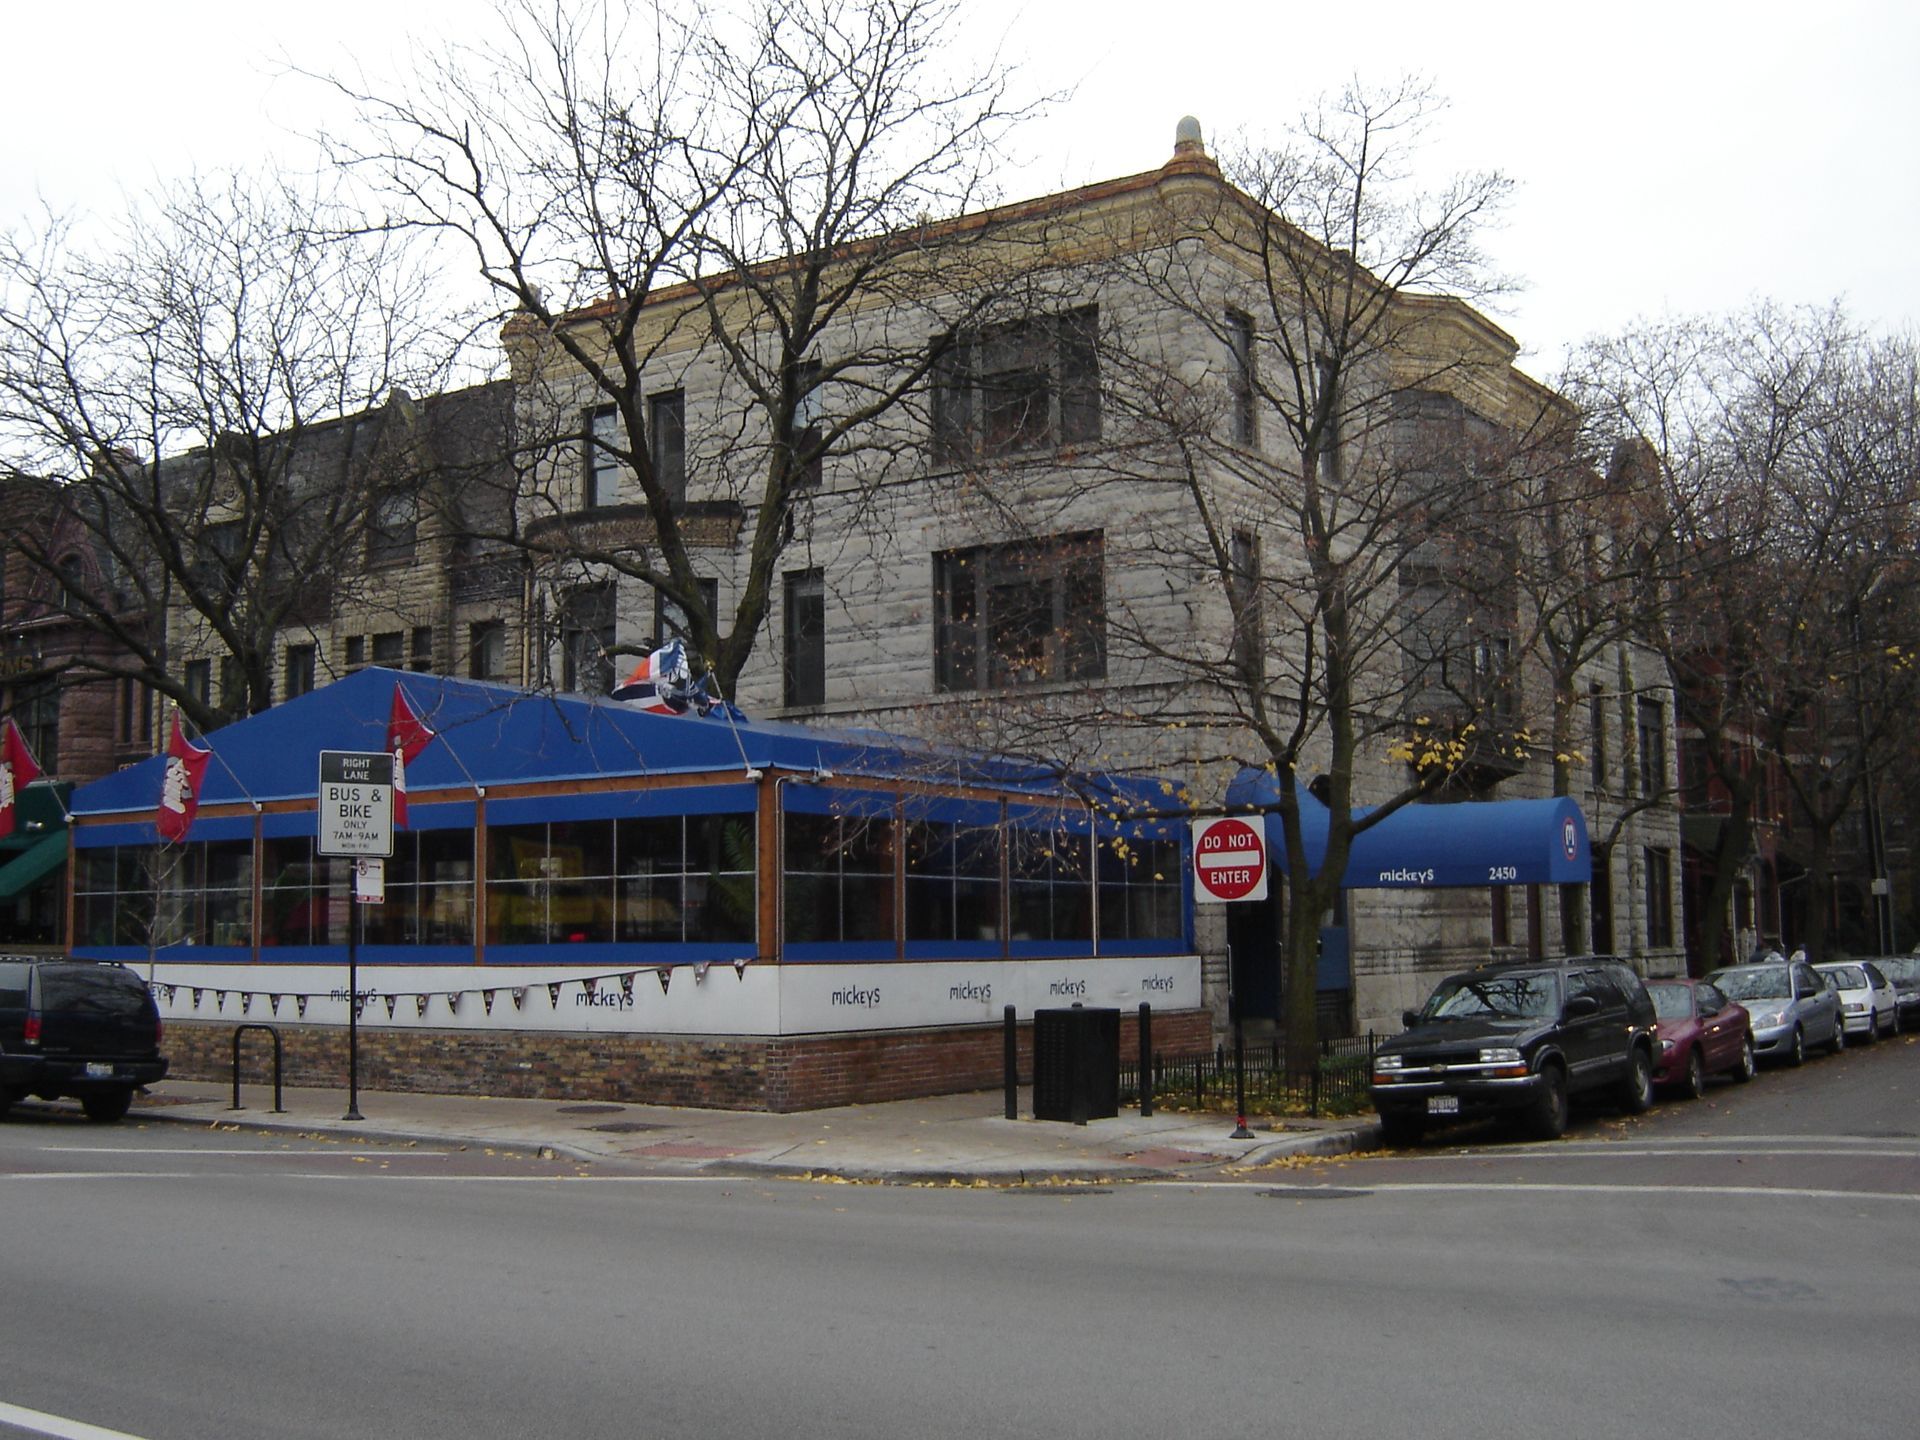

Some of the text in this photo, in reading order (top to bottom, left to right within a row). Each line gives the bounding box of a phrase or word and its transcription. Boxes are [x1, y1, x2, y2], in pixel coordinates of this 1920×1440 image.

[342, 758, 371, 768] RIGHT
[343, 770, 370, 780] LANE
[330, 787, 382, 802] BUS &
[340, 804, 372, 818] BIKE
[343, 820, 367, 829] ONLY
[333, 831, 378, 840] 7AM-9AM
[1204, 833, 1253, 849] DO NOT
[1211, 870, 1250, 884] ENTER
[1488, 866, 1517, 881] 2450
